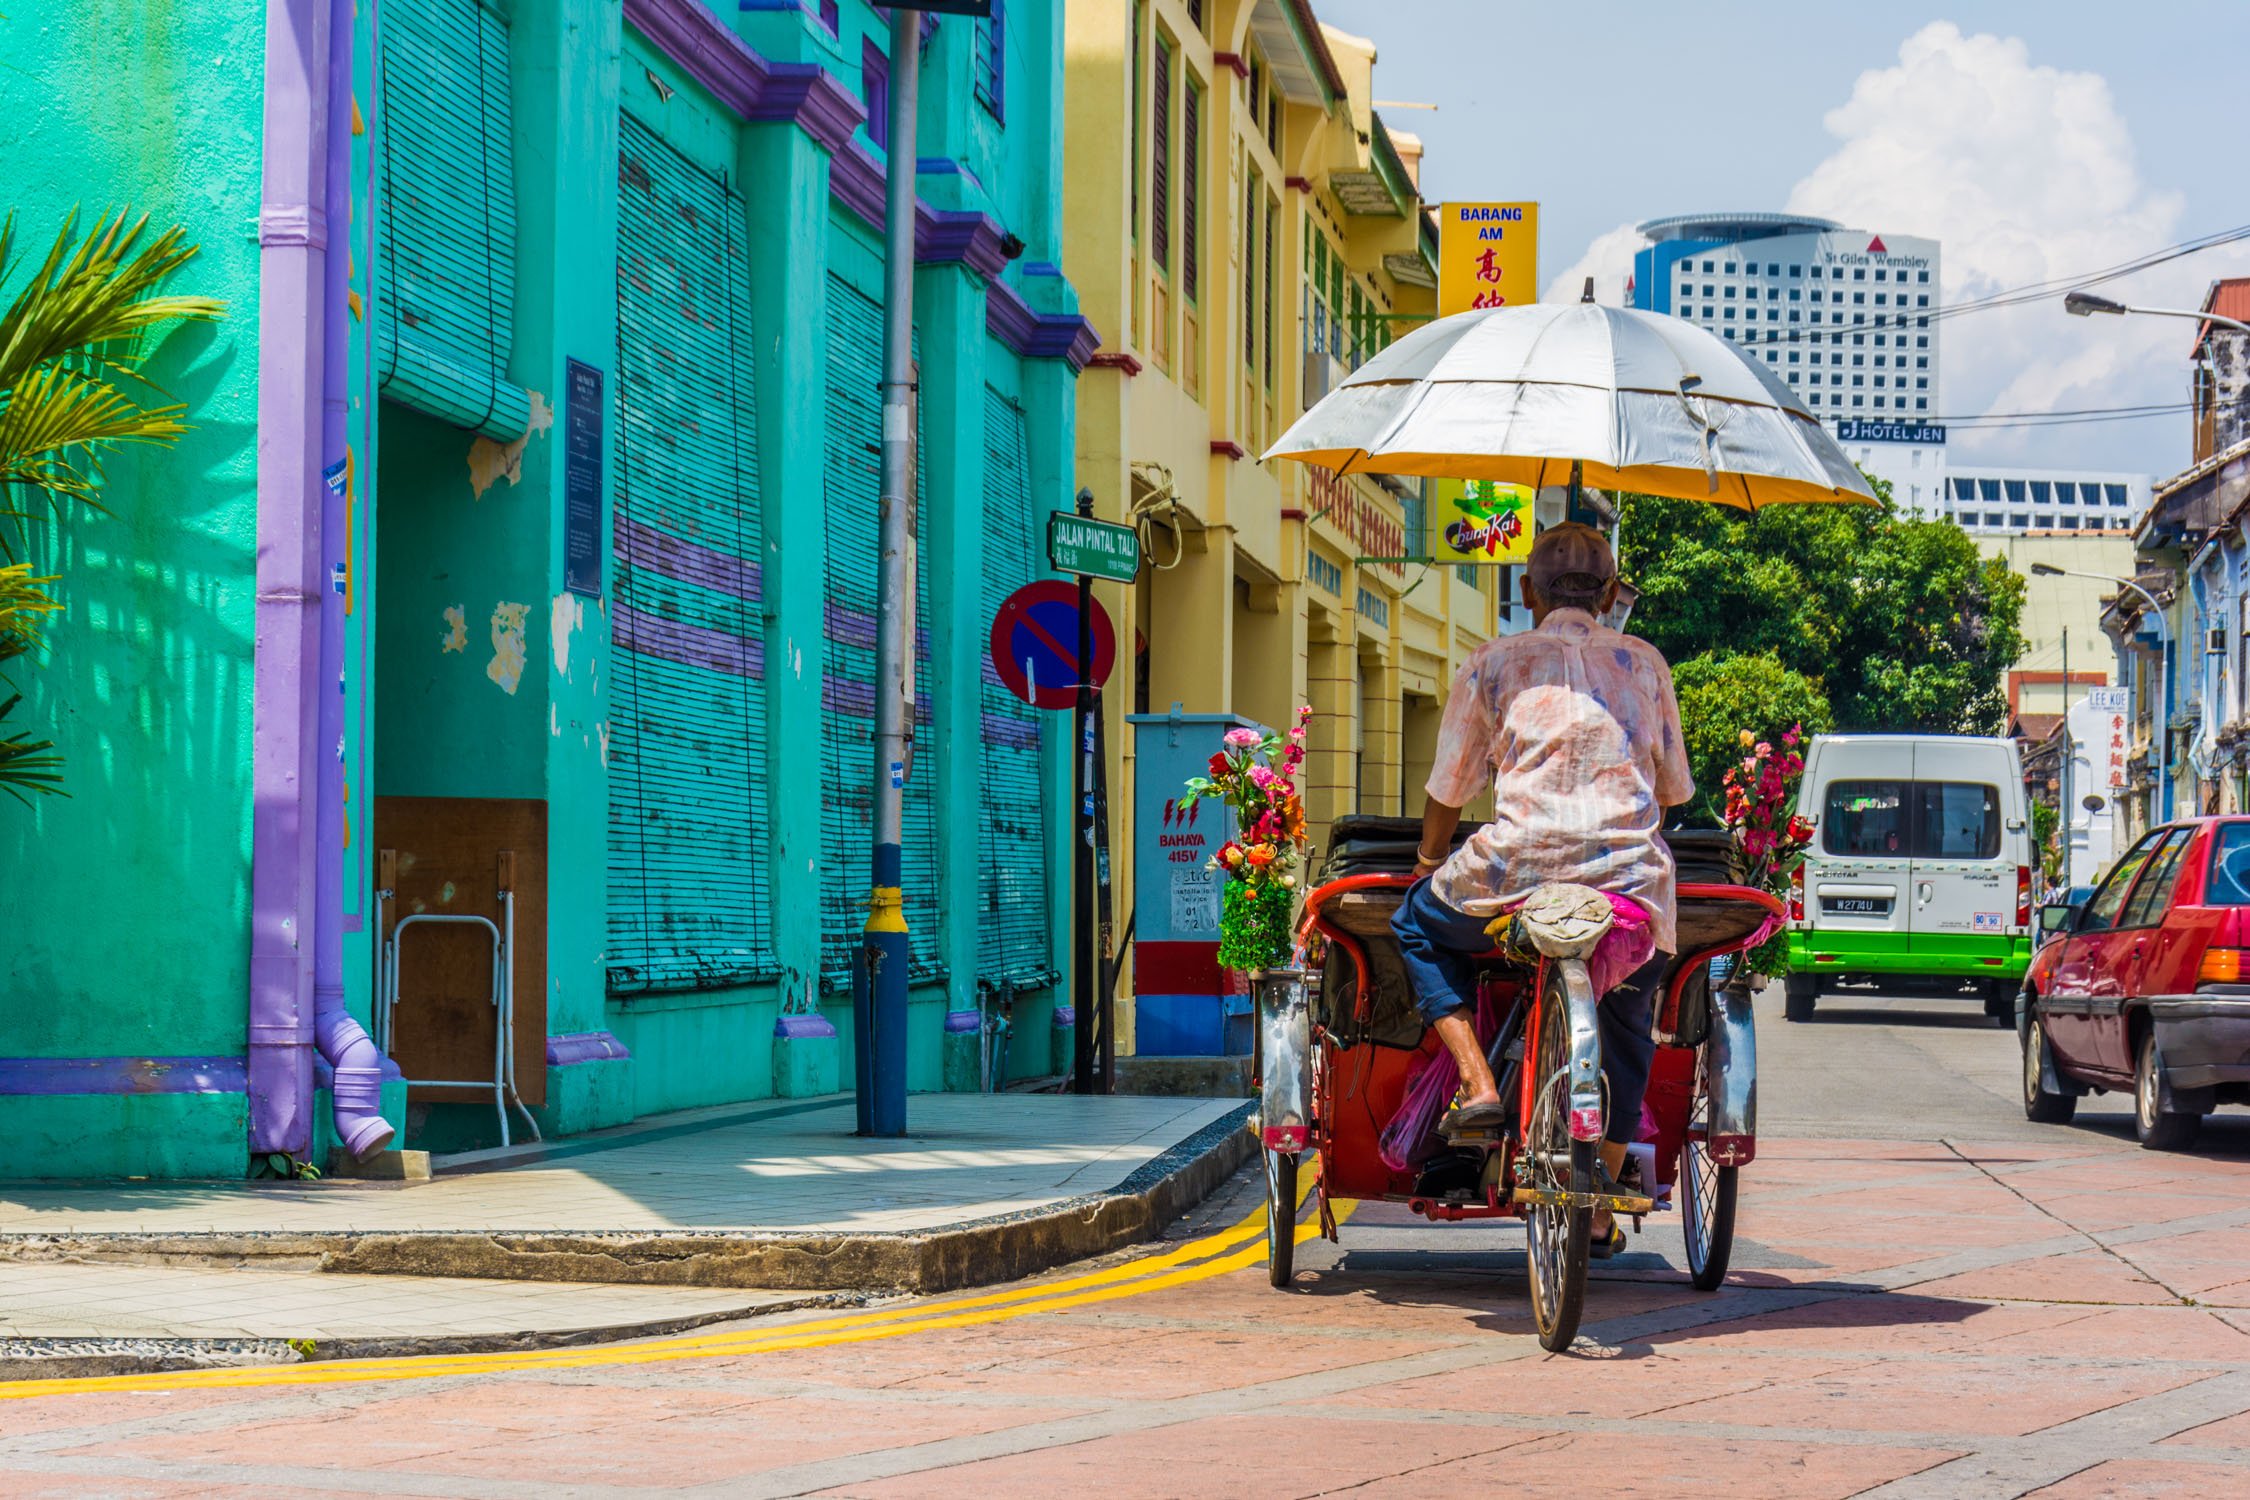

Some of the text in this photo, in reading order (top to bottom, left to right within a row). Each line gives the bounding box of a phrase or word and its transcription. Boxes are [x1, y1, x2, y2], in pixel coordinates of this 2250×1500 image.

[1460, 208, 1522, 221] BARANG
[1478, 227, 1503, 240] AM
[1825, 252, 1929, 268] St Giles Wembley
[1861, 425, 1910, 439] HOTEL
[1914, 428, 1942, 440] JEN
[1056, 522, 1134, 557] JALAN PINTAL TALI
[2090, 692, 2126, 705] LEE KOE
[1160, 834, 1206, 847] BAHAYA
[1168, 850, 1198, 863] 415V
